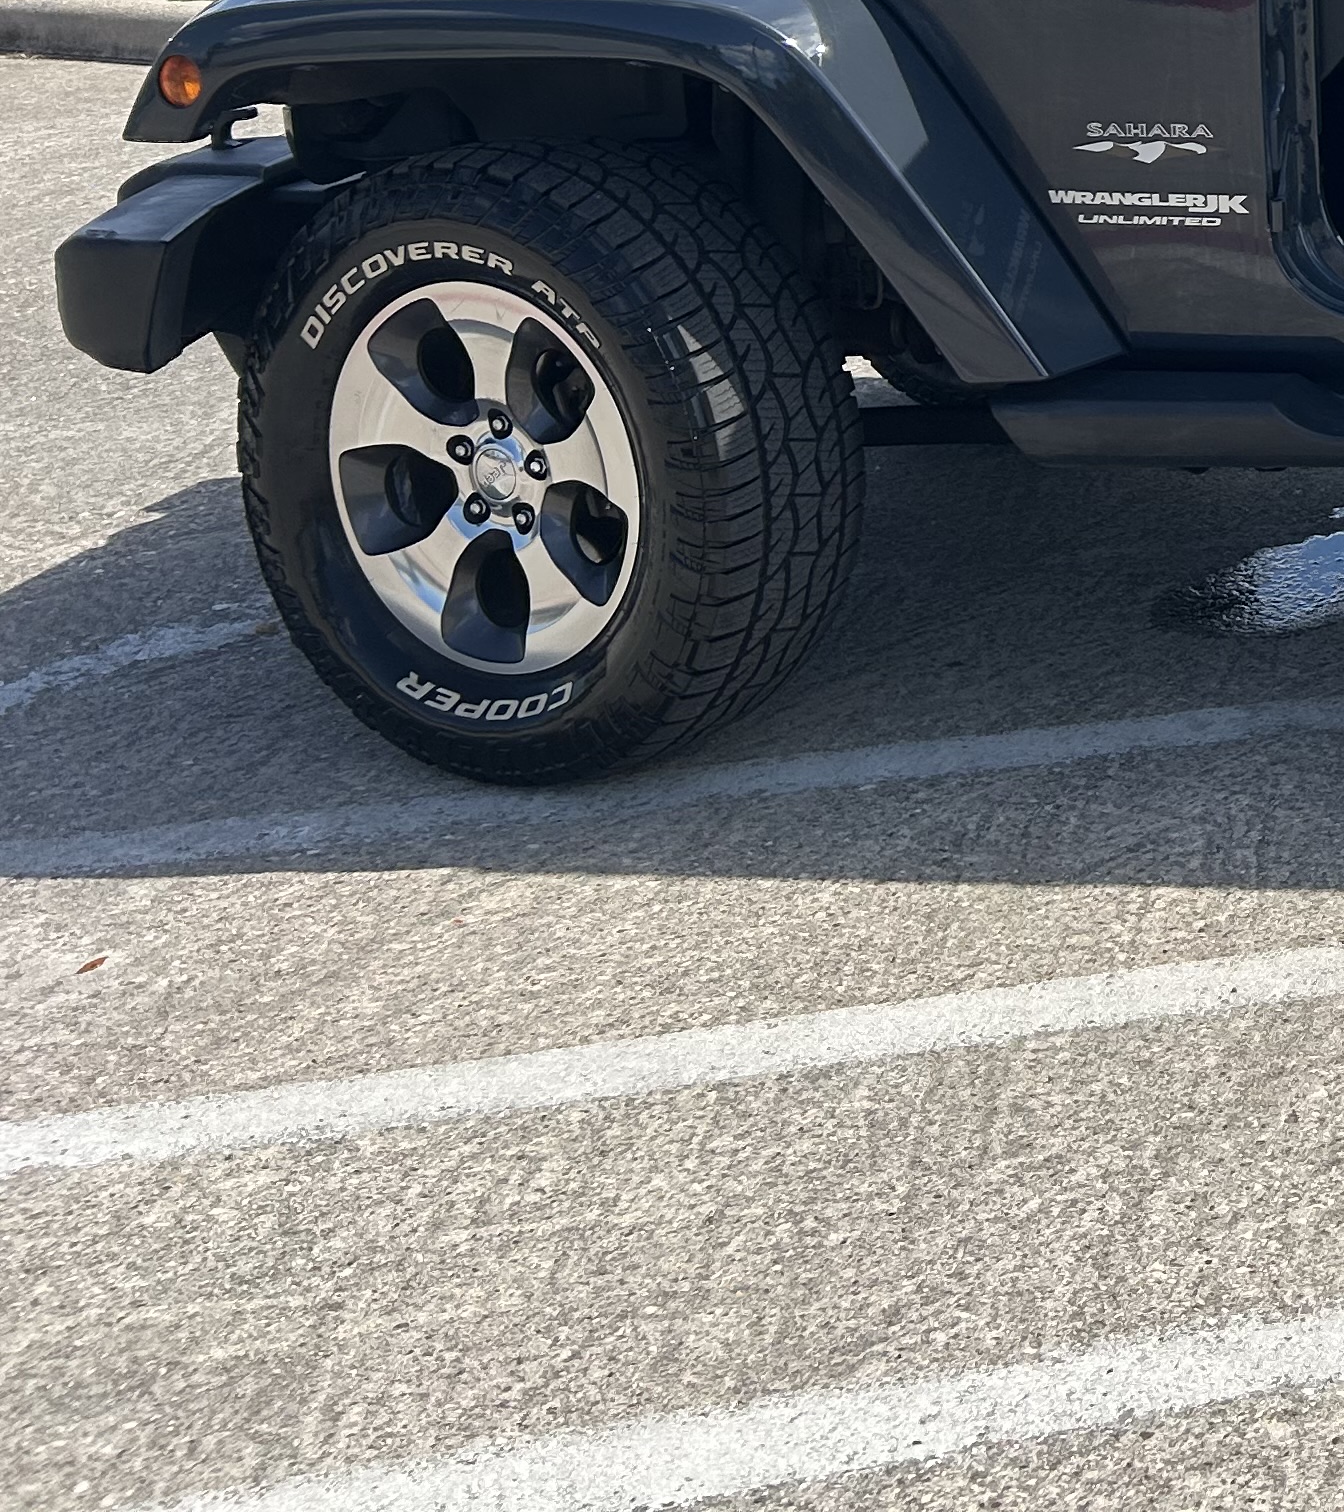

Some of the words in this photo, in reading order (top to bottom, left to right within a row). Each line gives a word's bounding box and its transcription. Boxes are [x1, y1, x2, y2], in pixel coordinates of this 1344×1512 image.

[1086, 122, 1214, 138] SAHARA
[1078, 214, 1222, 227] UNLIMITED
[300, 241, 514, 350] DISCOVERER
[531, 280, 600, 349] ATP
[396, 671, 573, 721] COOPER
